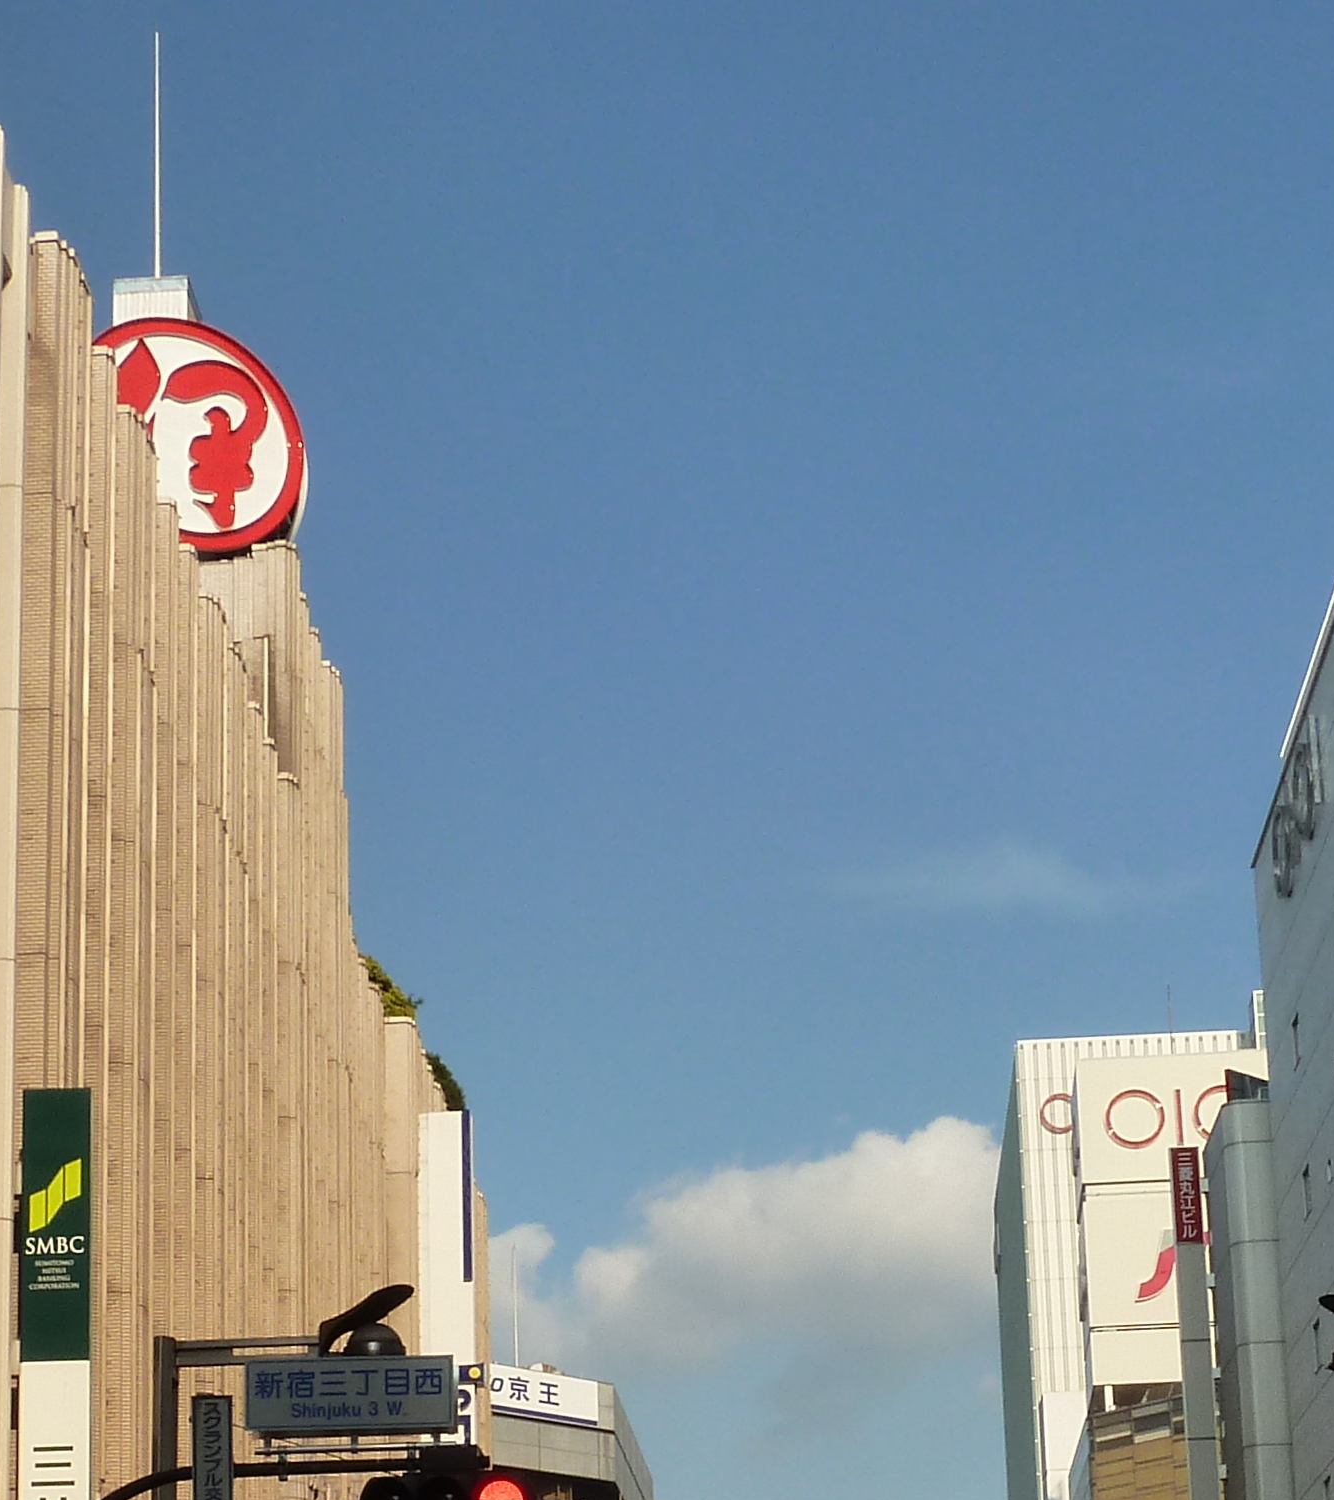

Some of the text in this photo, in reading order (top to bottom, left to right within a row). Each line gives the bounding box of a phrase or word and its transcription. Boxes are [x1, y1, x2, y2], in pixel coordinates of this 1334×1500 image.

[25, 1236, 85, 1255] SMBC
[254, 1368, 443, 1399] 新宿三丁目西
[508, 1375, 561, 1407] 京王
[291, 1401, 362, 1420] Shinjuku
[368, 1401, 378, 1417] 3
